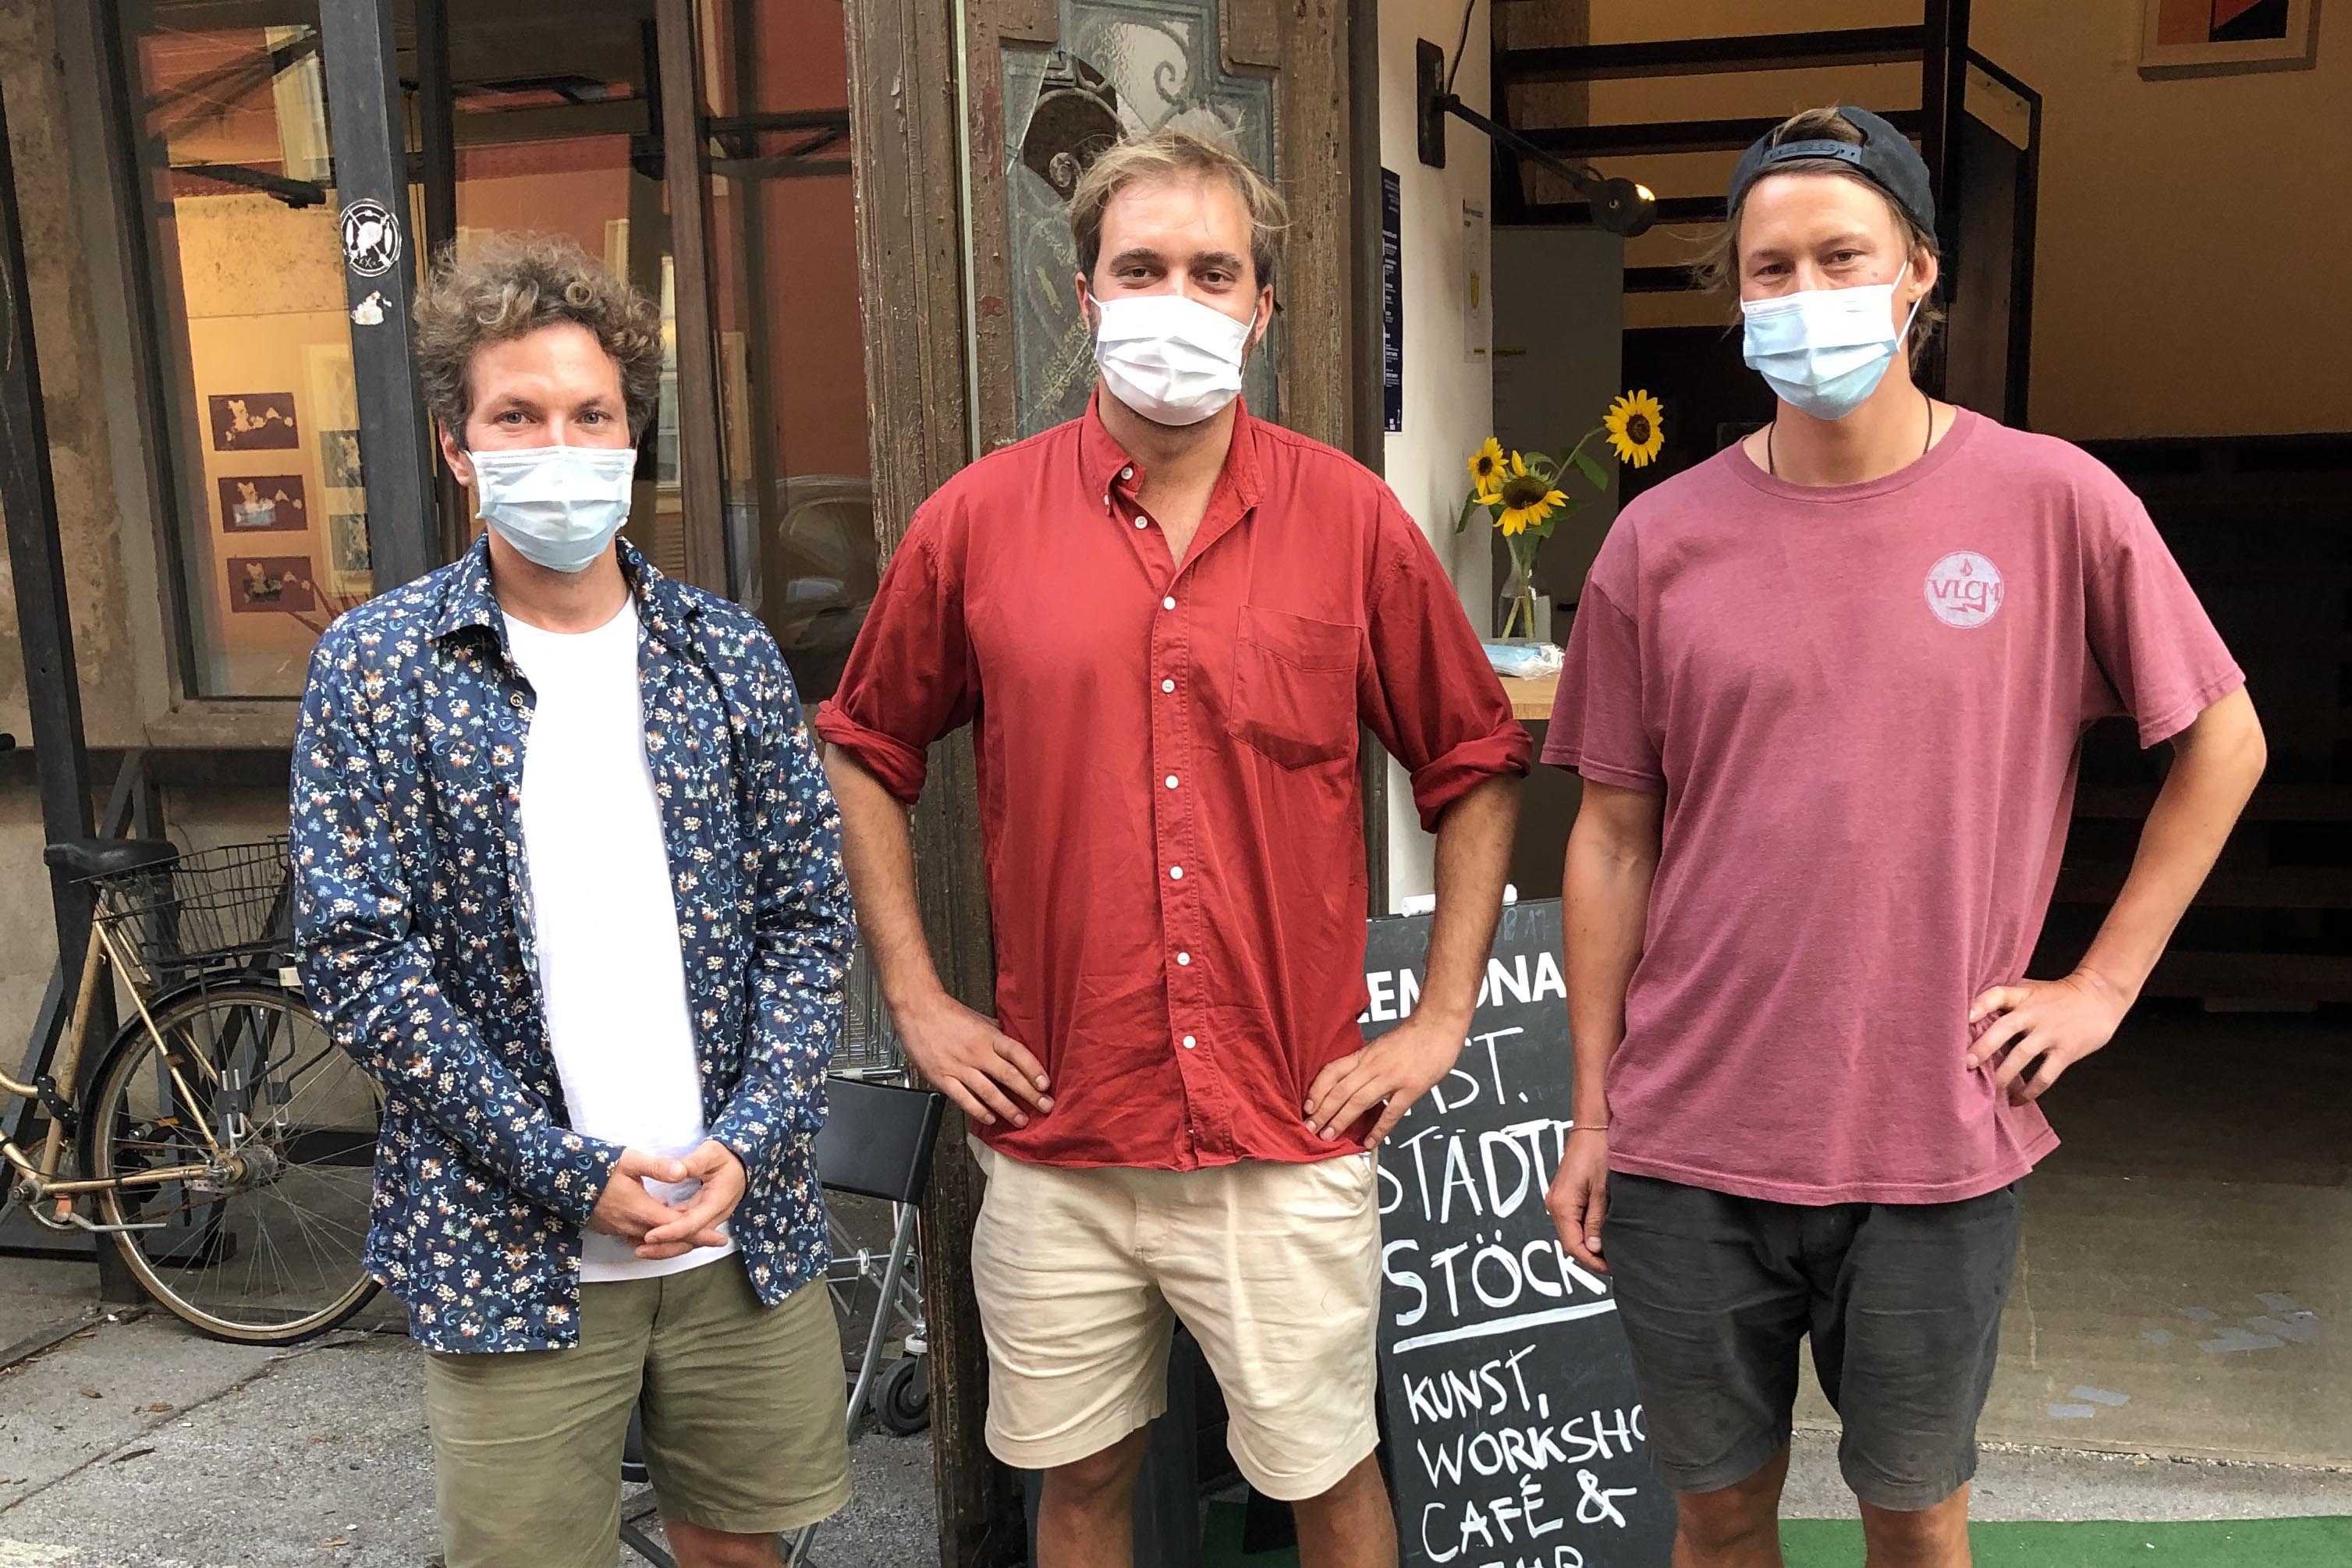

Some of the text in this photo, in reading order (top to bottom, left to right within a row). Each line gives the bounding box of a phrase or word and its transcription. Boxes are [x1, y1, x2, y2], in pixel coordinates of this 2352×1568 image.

[1357, 952, 1567, 1023] ENA
[1378, 1118, 1573, 1224] STÄDT
[1382, 1229, 1607, 1325] STÖCK
[1403, 1343, 1549, 1425] KUNST,
[1422, 1469, 1638, 1563] CAFÉ &
